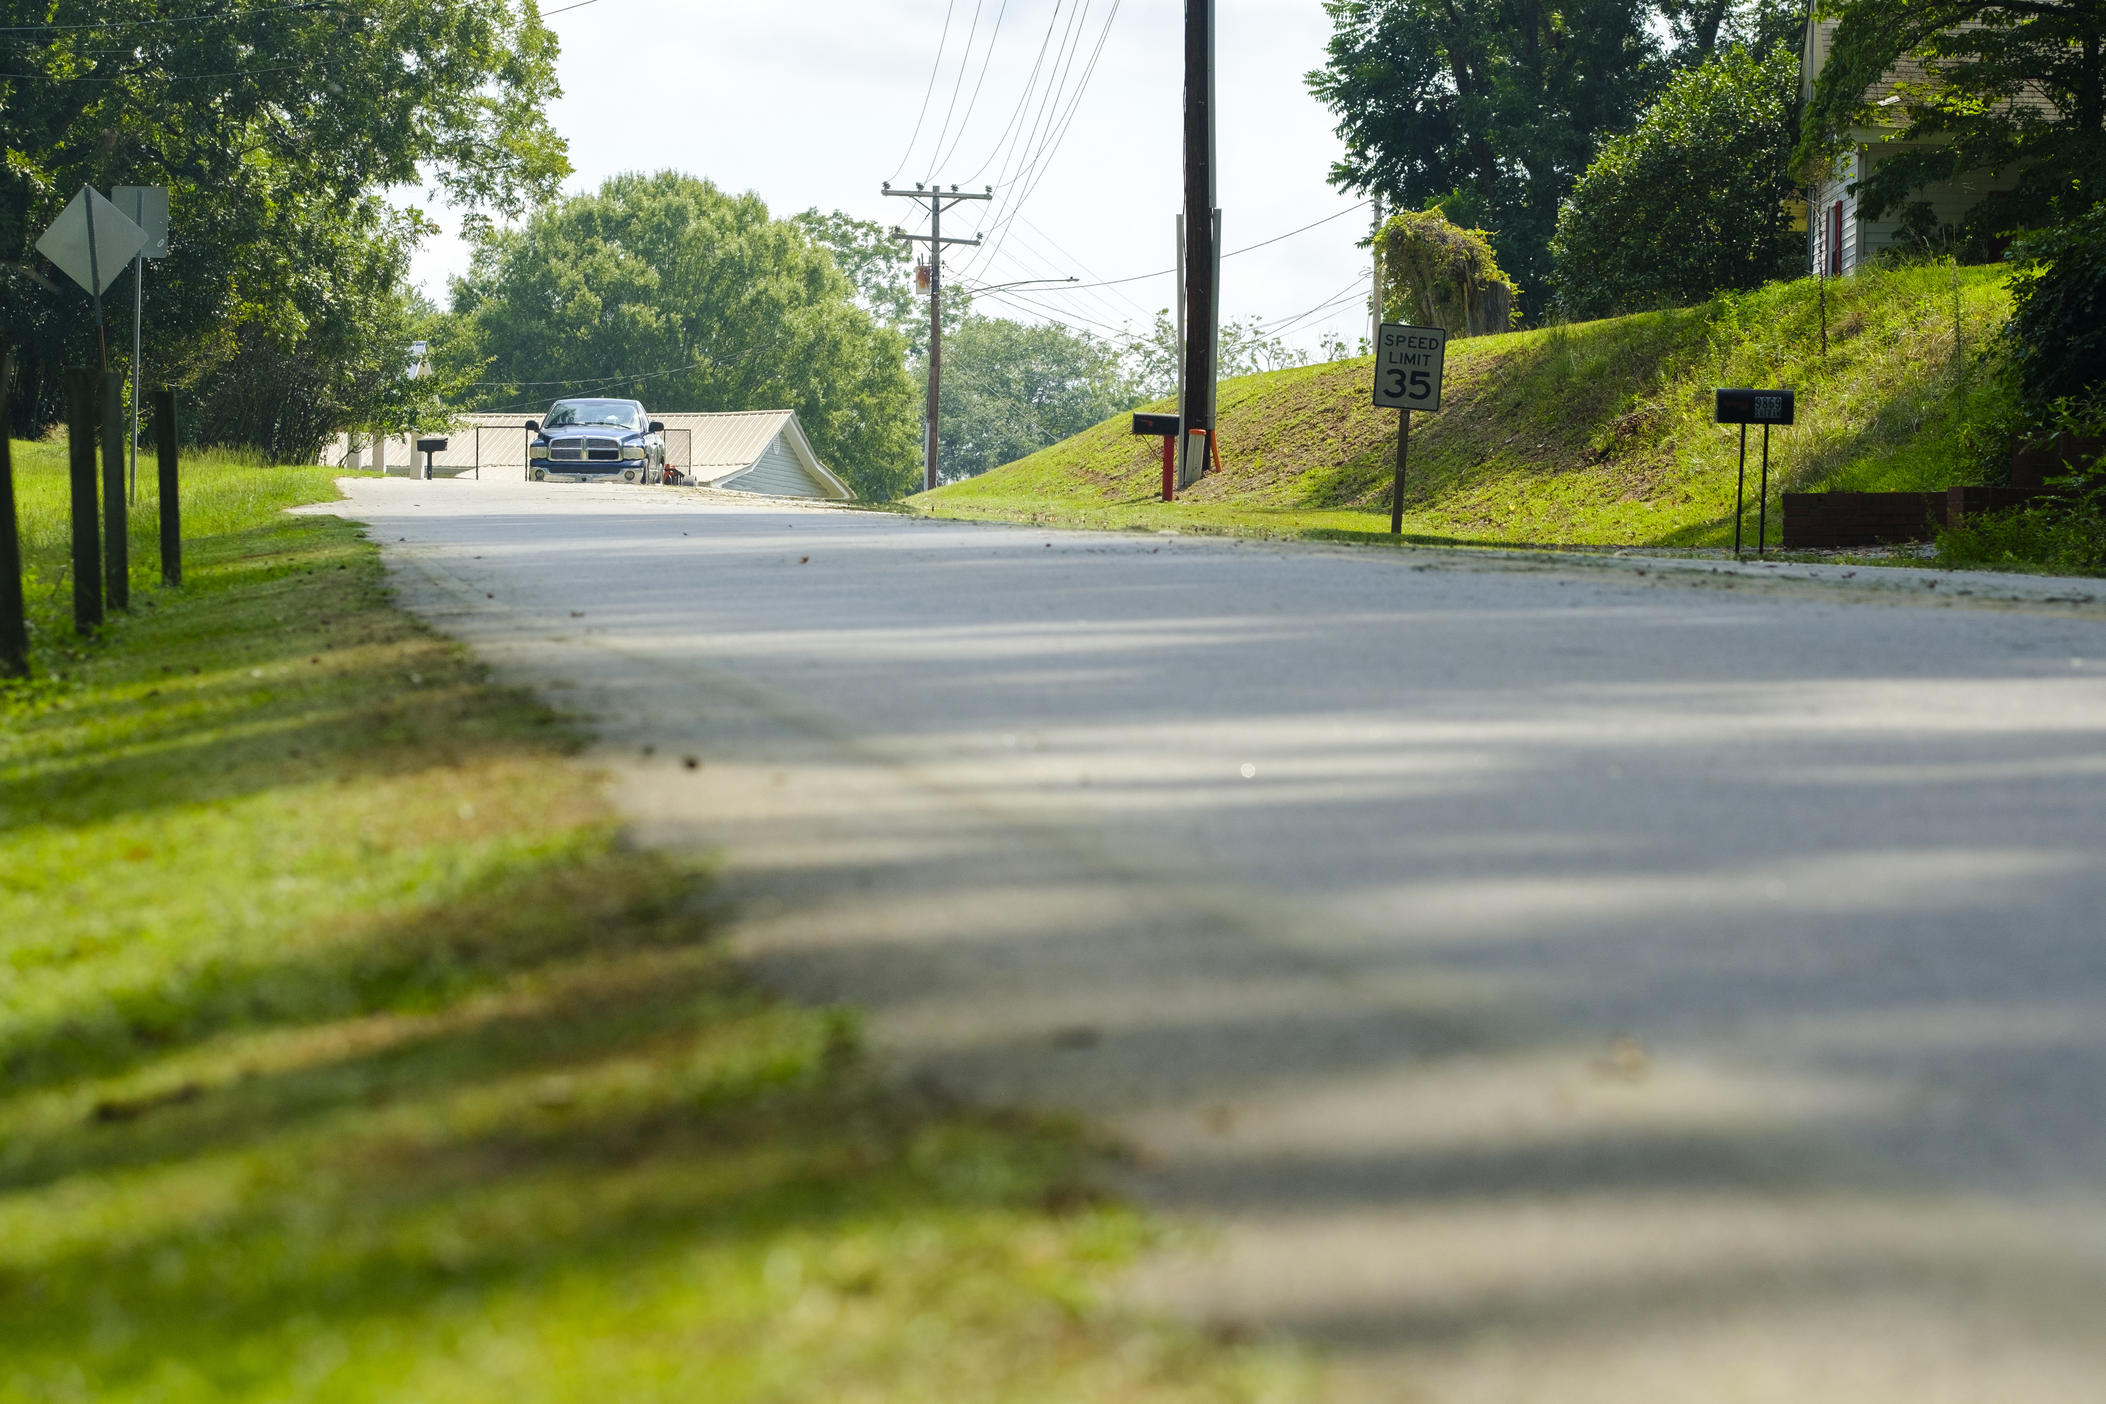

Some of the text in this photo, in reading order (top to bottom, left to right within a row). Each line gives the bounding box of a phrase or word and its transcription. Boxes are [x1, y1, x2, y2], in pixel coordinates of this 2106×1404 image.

[1384, 334, 1439, 350] SPEED
[1388, 351, 1432, 367] LIMIT
[1383, 369, 1432, 400] 35
[1755, 397, 1781, 409] 9869
